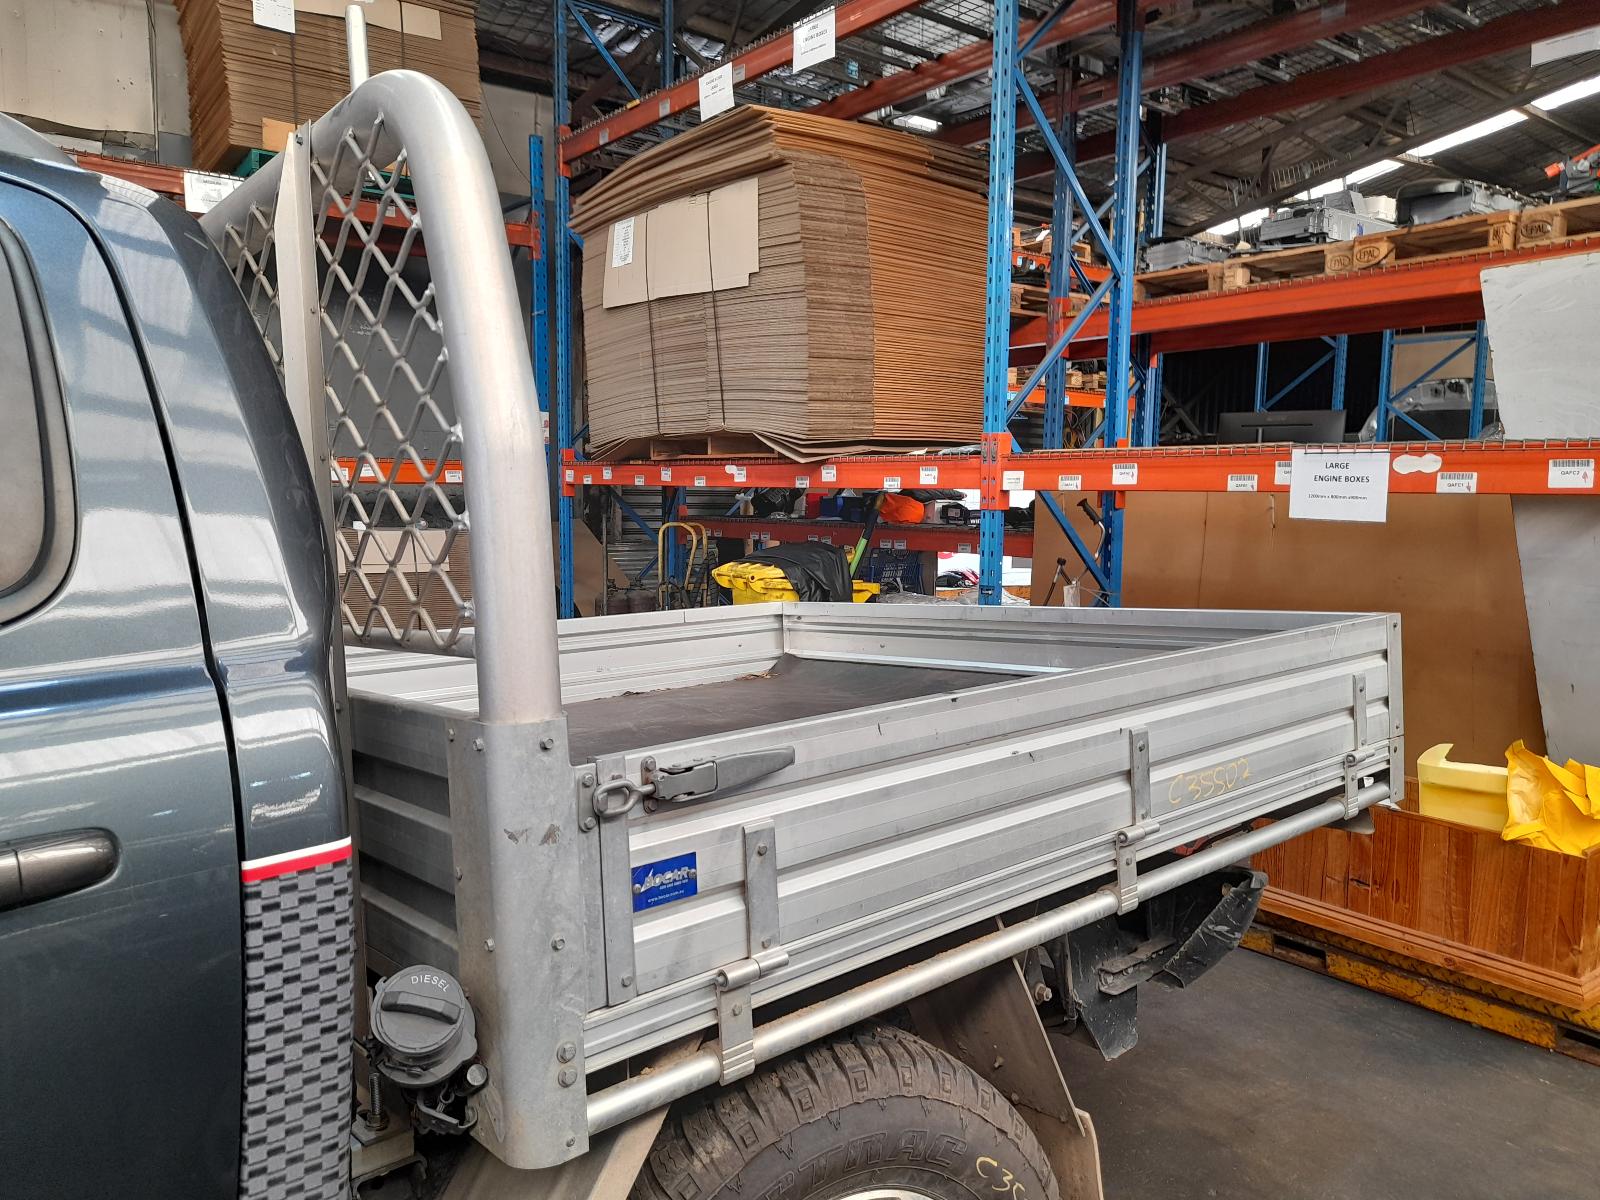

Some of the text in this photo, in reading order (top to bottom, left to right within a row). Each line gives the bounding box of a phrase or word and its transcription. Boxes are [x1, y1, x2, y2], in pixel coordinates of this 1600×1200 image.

[1359, 249, 1378, 260] EPAL
[1325, 462, 1350, 470] LARGE
[1313, 474, 1370, 483] ENGINE BOXES
[411, 974, 450, 992] DIESEL
